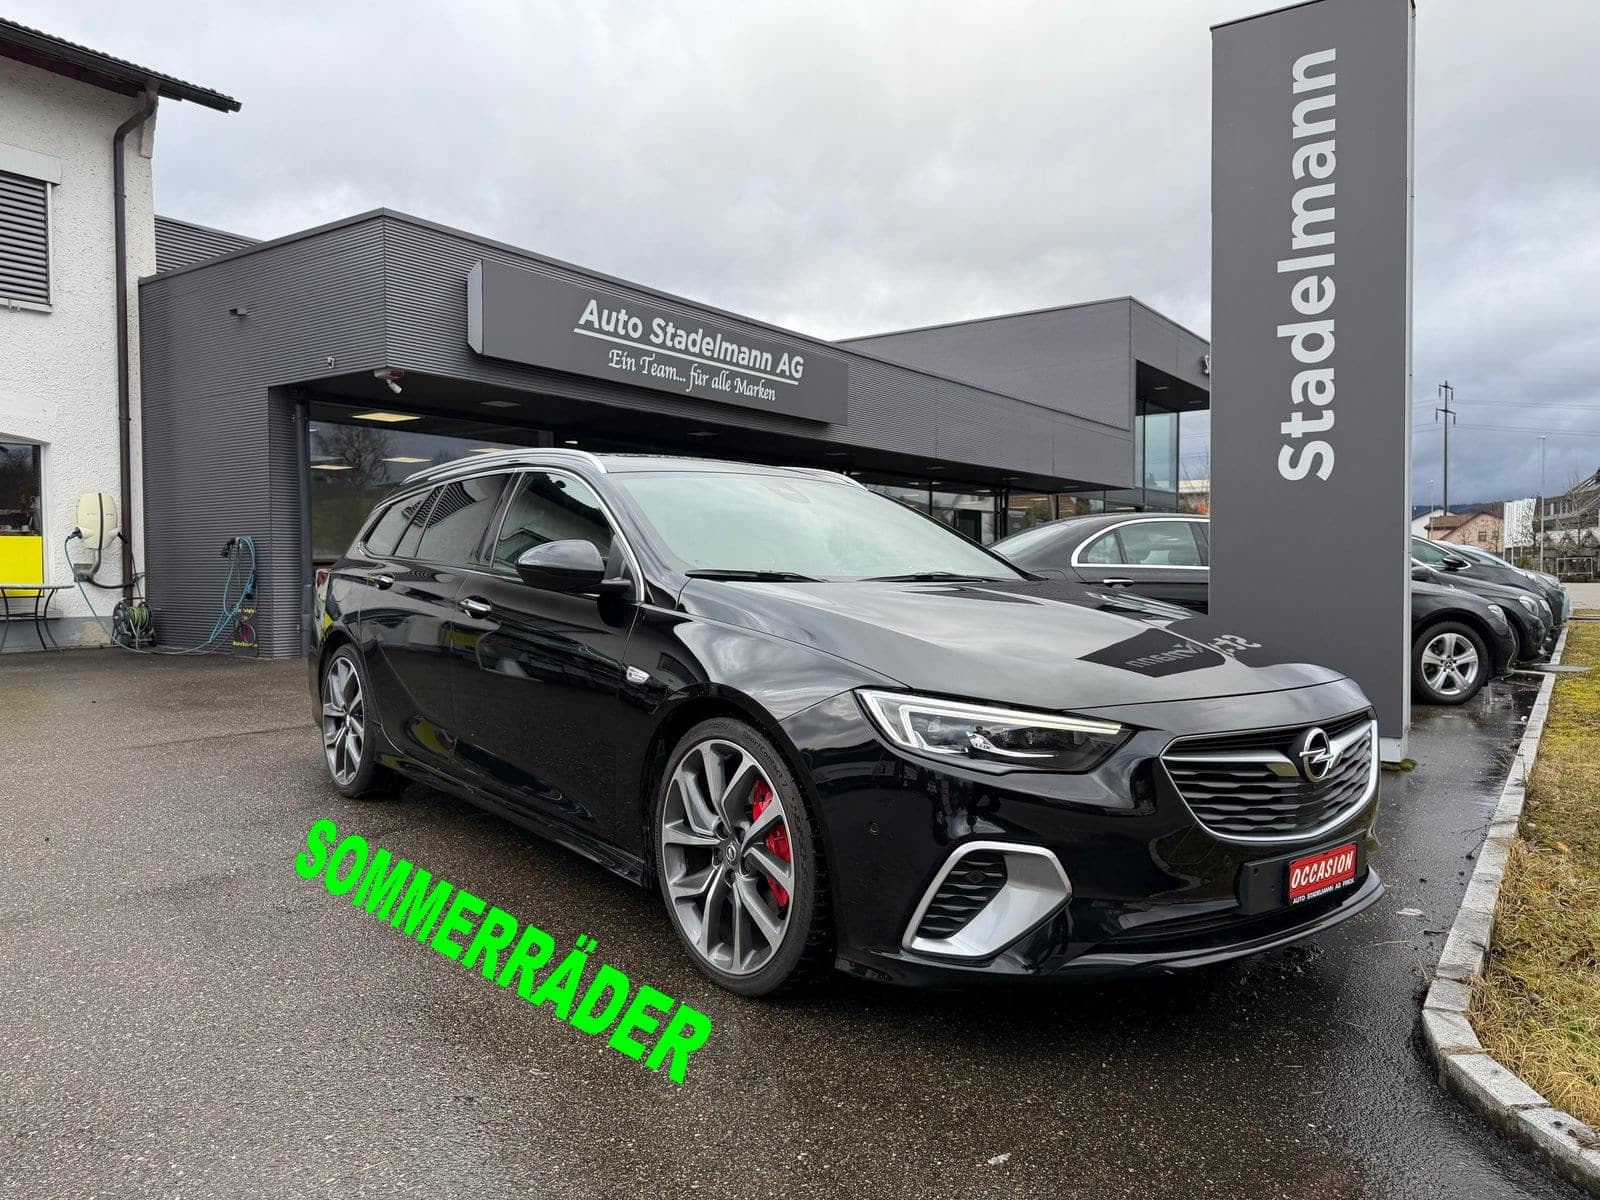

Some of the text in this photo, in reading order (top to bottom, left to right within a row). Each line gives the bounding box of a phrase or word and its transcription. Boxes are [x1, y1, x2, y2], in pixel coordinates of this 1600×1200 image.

[1277, 48, 1336, 481] Stadelmann
[578, 299, 804, 379] Auto Stadelmann AG
[608, 349, 777, 401] Ein Team... für alle Marken
[1291, 851, 1354, 889] OCCASION
[1293, 895, 1306, 904] AUTO
